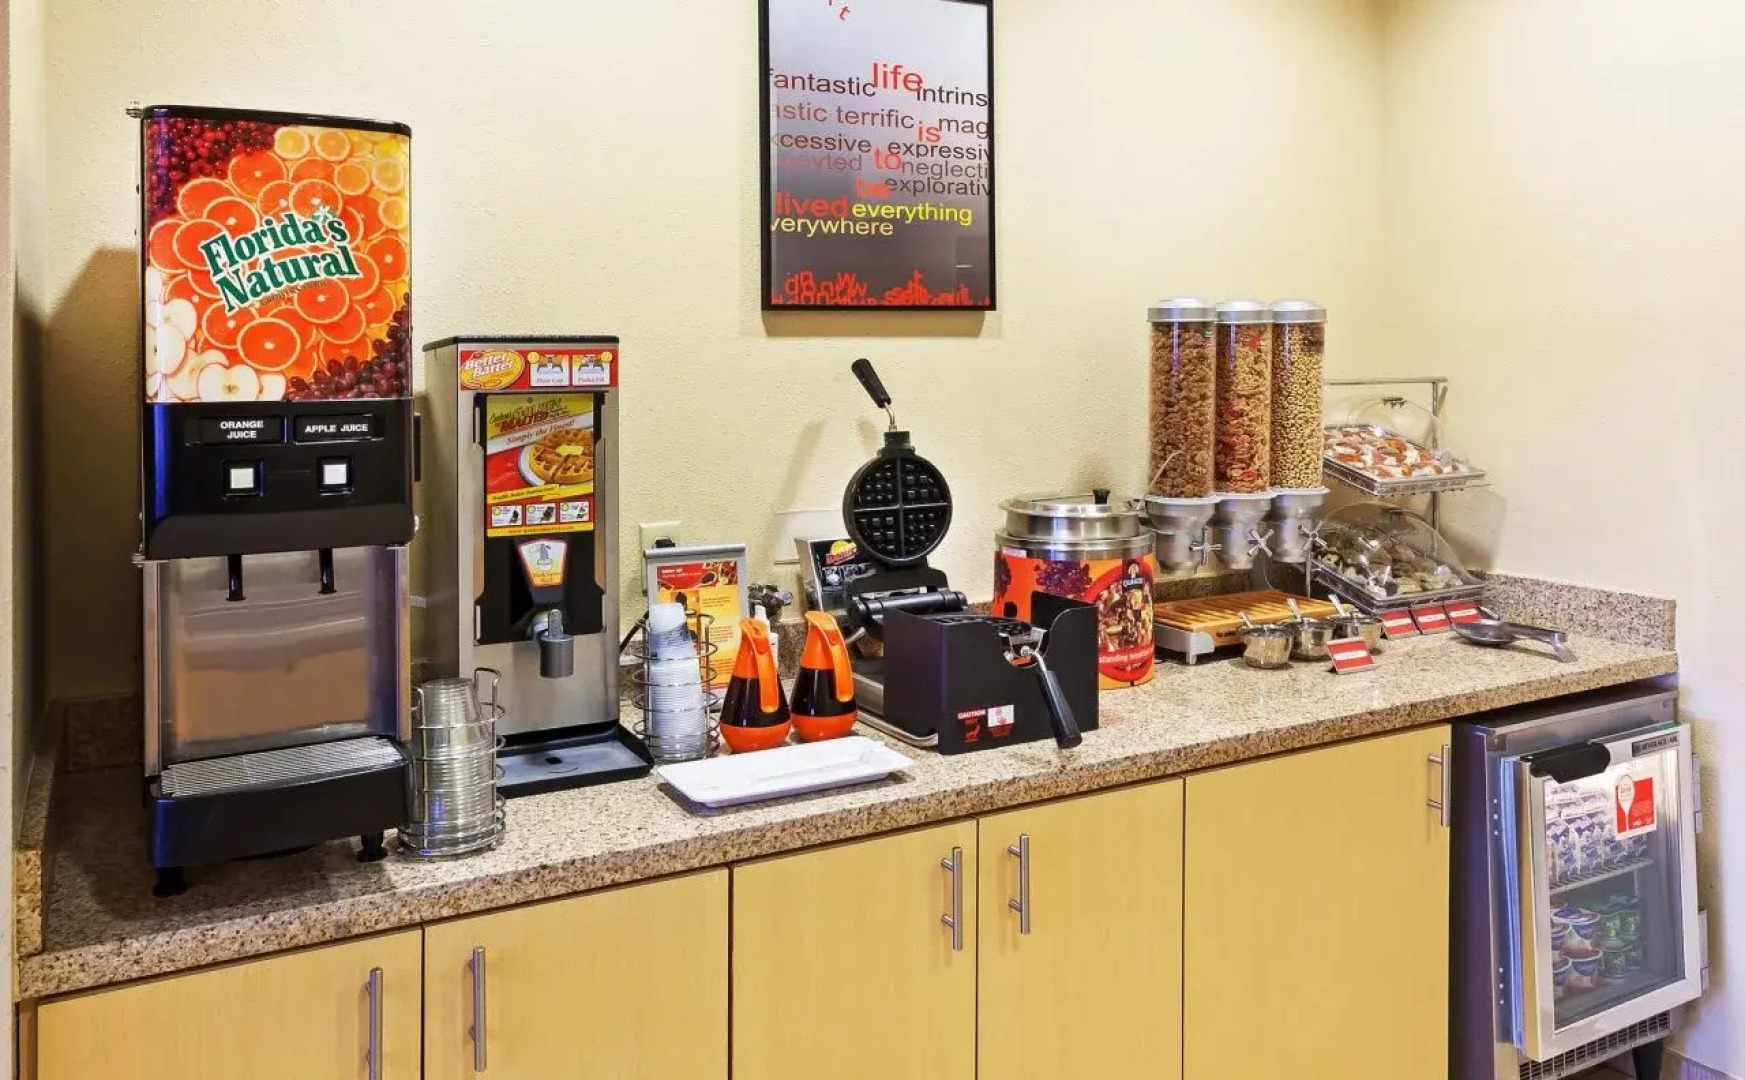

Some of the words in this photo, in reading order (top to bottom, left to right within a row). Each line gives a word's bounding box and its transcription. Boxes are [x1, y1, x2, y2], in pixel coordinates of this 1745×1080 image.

[873, 63, 923, 92] life
[836, 105, 914, 129] terrific
[774, 133, 872, 153] cessive
[918, 120, 941, 142] is
[874, 146, 903, 170] to
[775, 190, 849, 218] lived
[852, 203, 972, 226] everything
[200, 213, 348, 276] Florida's
[216, 244, 361, 313] Natural
[220, 420, 263, 429] ORANGE
[227, 430, 257, 439] JUICE
[304, 424, 337, 433] APPLE
[340, 424, 369, 432] JUICE
